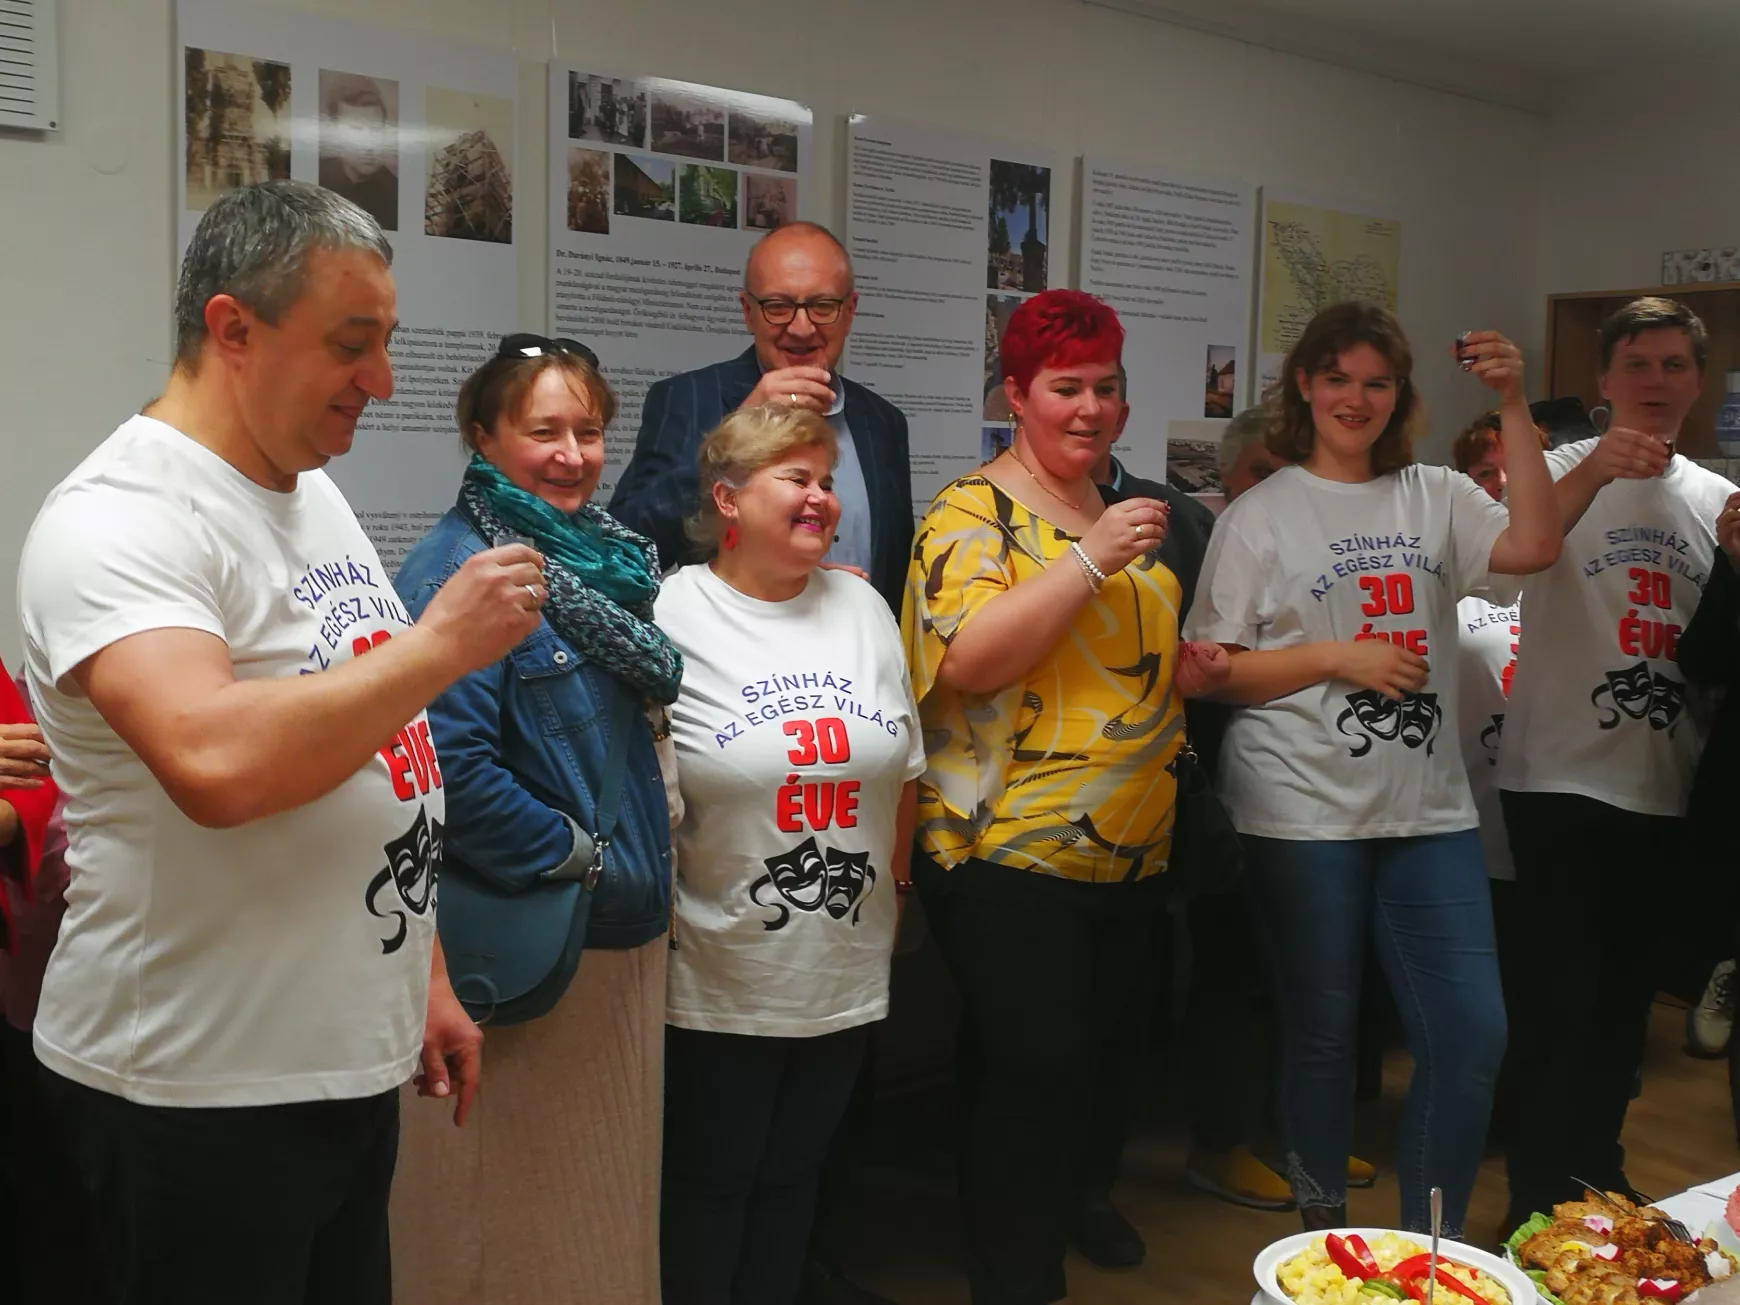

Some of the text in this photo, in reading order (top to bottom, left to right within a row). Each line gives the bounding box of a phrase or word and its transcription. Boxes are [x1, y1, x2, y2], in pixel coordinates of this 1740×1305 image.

[556, 249, 567, 259] Dr.
[568, 250, 593, 262] Darányi
[594, 252, 614, 264] Ignác,
[714, 266, 741, 277] Budapest
[1329, 531, 1421, 556] SZÍNHÁZ
[1582, 558, 1605, 579] AZ
[1603, 546, 1662, 566] EGÉSZ
[1605, 525, 1690, 556] SZÍNHÁZ
[293, 555, 379, 611] SZÍNHÁZ
[1310, 574, 1335, 602] AZ
[1332, 553, 1394, 578] EGÉSZ
[1358, 573, 1415, 617] 30
[1627, 567, 1672, 610] 30
[299, 644, 330, 676] Z
[320, 597, 370, 650] EGÉSZ
[1467, 608, 1520, 634] AZ EGÉ
[1618, 608, 1682, 662] ÉVE
[741, 670, 853, 704] SZÍNHÁZ
[714, 695, 899, 750] AZ EGÉSZ VILÁG
[782, 716, 851, 767] 30
[776, 772, 861, 833] ÉVE
